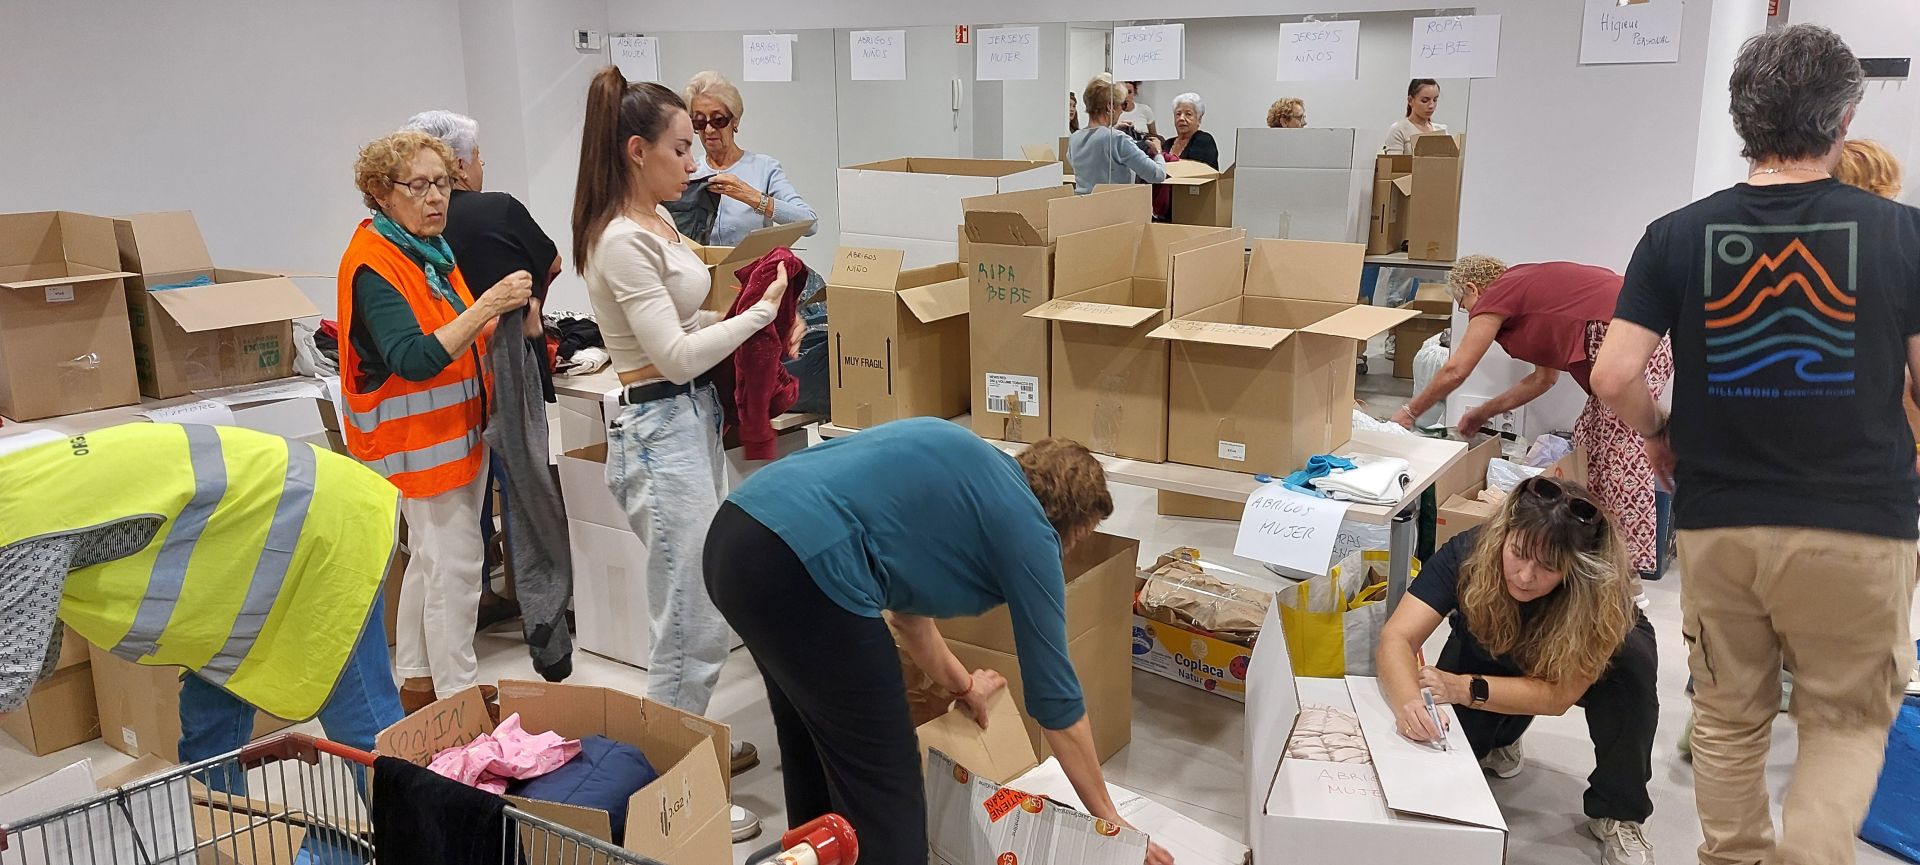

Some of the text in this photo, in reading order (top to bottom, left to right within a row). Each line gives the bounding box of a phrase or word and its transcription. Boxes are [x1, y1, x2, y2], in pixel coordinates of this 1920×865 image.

[1426, 19, 1463, 35] ROPA
[987, 33, 1031, 45] JERSEYS
[1120, 31, 1163, 44] JERSEYS
[1291, 29, 1343, 44] JERSEYS
[990, 52, 1024, 63] MUJER
[1295, 49, 1335, 62] NIÑOS
[1420, 40, 1472, 59] BEBE
[986, 282, 1032, 305] BEBE
[844, 356, 884, 370] MUY FRAGIL
[1251, 496, 1315, 517] ABRIGOS
[1258, 520, 1315, 540] MUJER
[1174, 653, 1225, 679] Coplaca
[1178, 668, 1204, 684] Natur
[1327, 784, 1382, 798] MUJE
[990, 791, 1028, 821] ONTIENE
